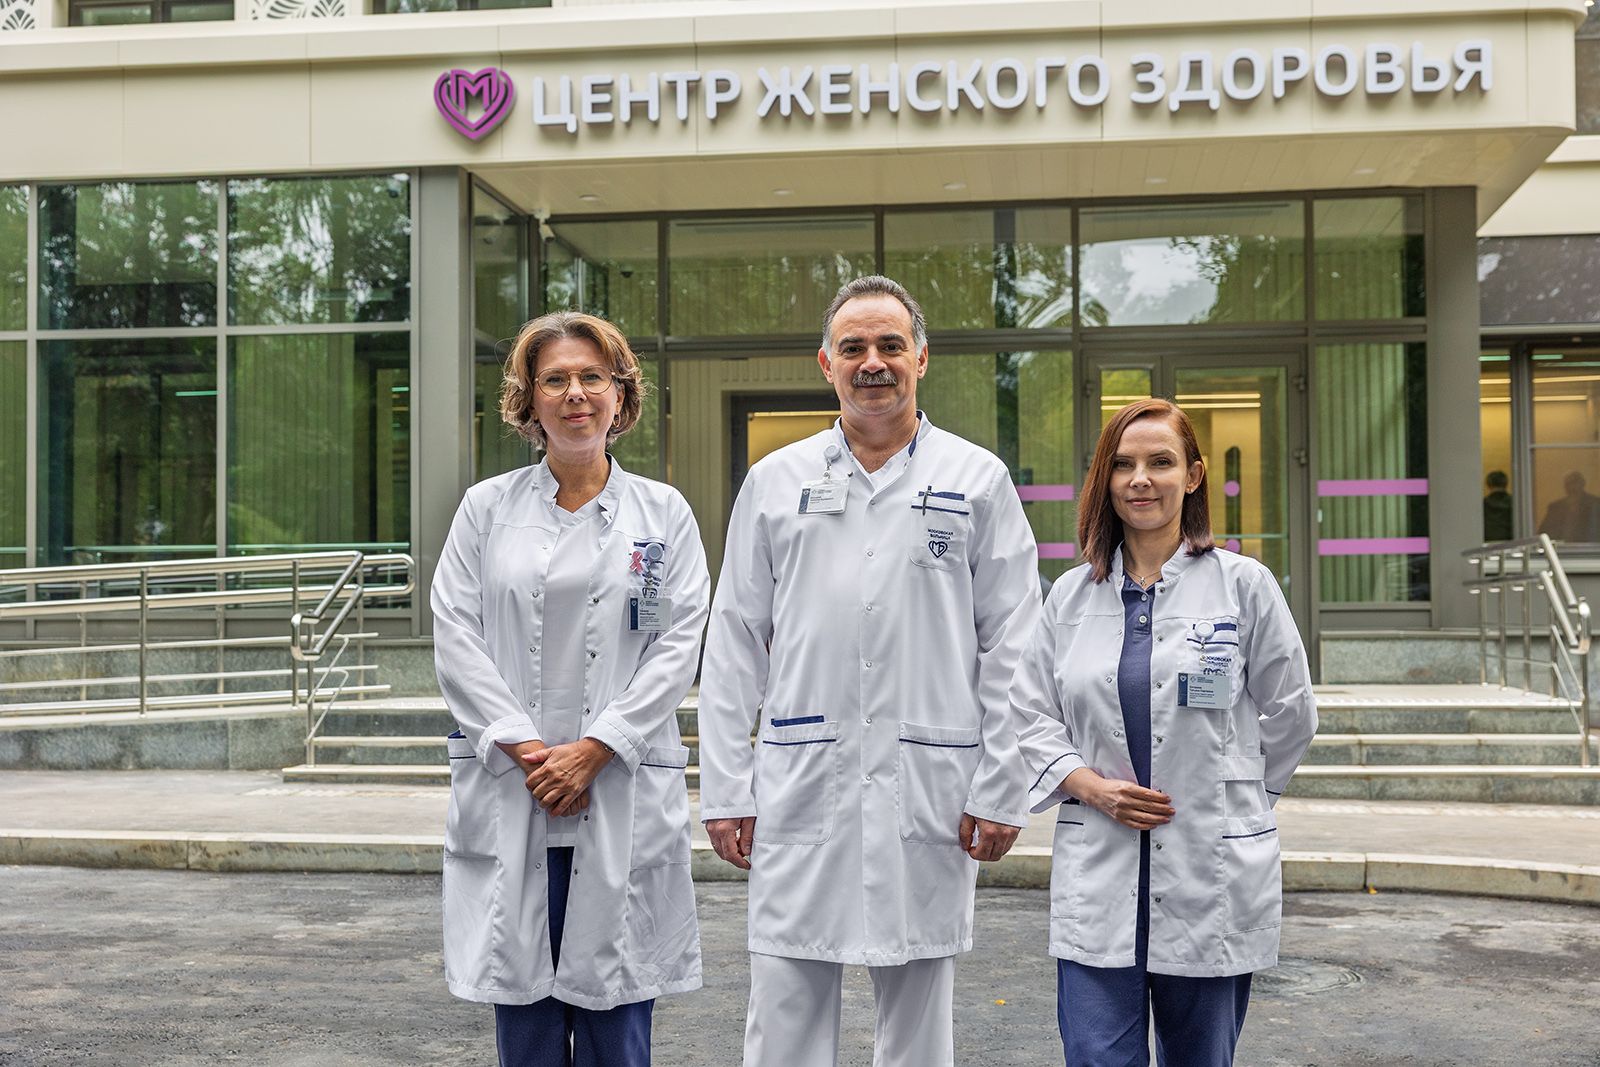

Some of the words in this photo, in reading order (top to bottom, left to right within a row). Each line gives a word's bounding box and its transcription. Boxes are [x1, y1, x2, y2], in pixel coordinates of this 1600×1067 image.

[532, 70, 742, 133] ЦЕНТР
[756, 55, 1110, 118] ЖЕНСКОГО
[1129, 40, 1493, 112] ЗДОРОВЬЯ
